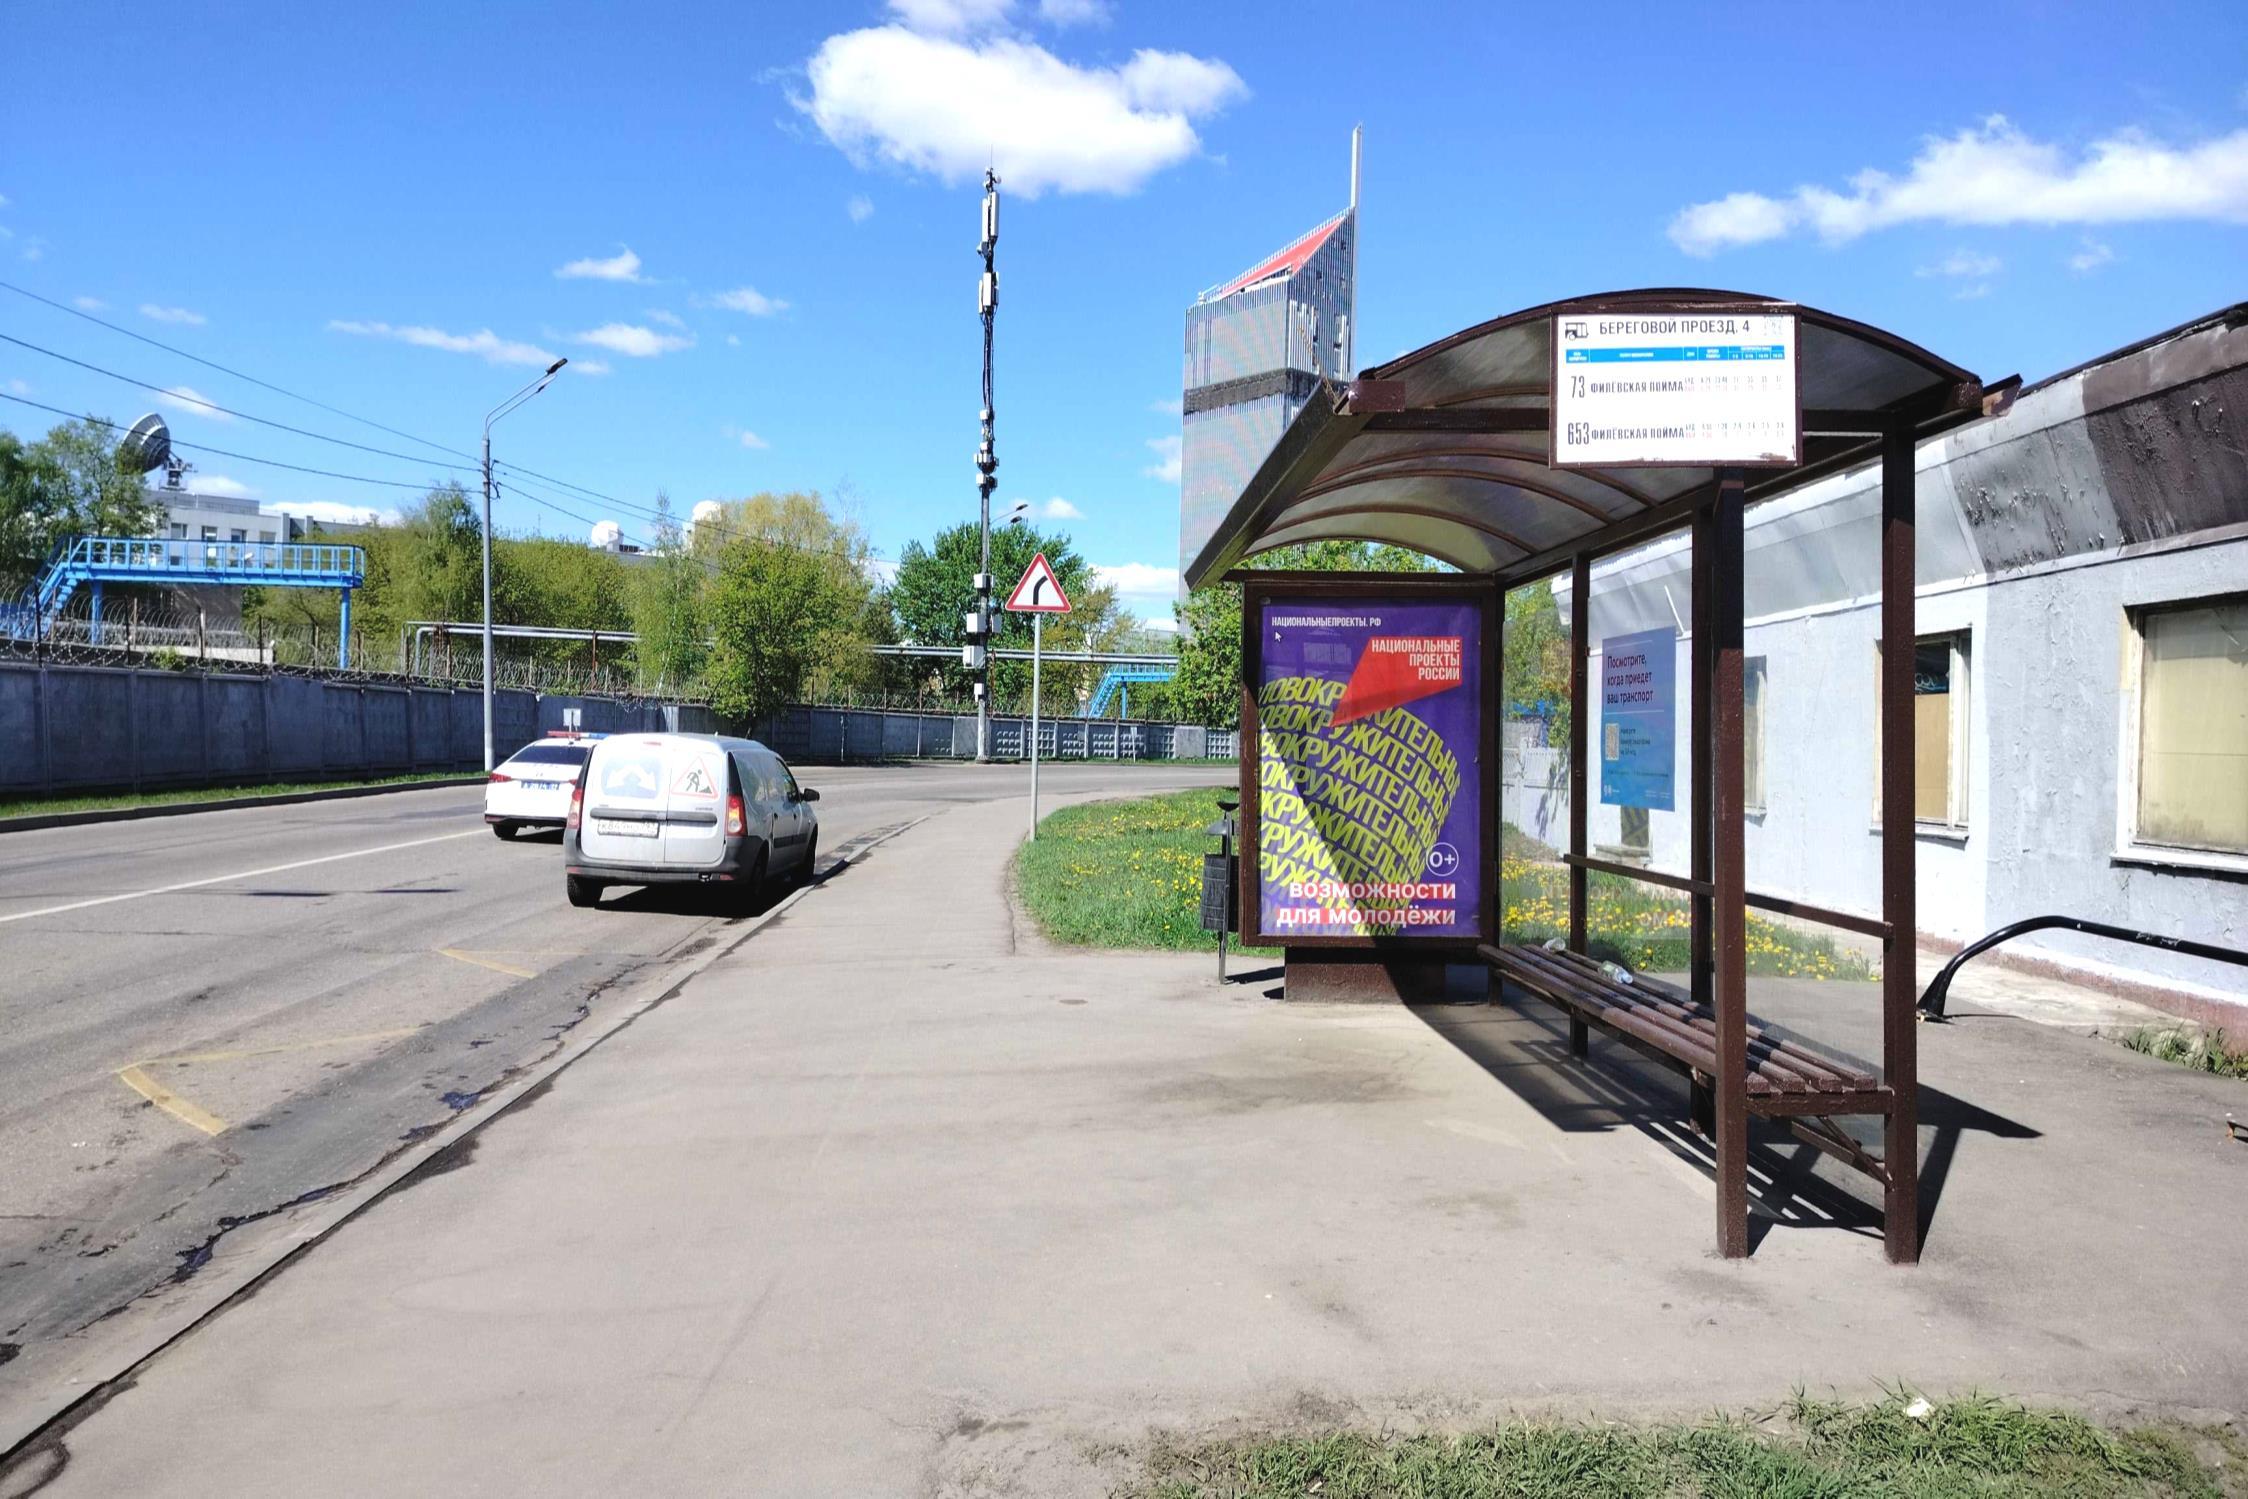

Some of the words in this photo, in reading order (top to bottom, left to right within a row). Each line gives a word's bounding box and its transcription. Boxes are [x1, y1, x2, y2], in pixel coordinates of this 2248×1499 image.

[1600, 317, 1677, 334] БЕРЕГОВОЙ
[1743, 319, 1750, 333] 4
[1571, 375, 1586, 399] 73
[1567, 422, 1590, 446] 653
[1371, 639, 1461, 654] НАЦИОНАЛЬНЫЕ
[1409, 653, 1460, 667] ПРОЕКТЫ
[1607, 653, 1647, 669] Посмотрите,
[1418, 667, 1460, 681] РОССИИ
[1607, 674, 1624, 687] когда
[1625, 671, 1652, 687] приедет
[1607, 692, 1619, 705] ваш
[1620, 690, 1654, 707] транспорт
[1428, 851, 1456, 868] 0+
[1276, 908, 1321, 928] для
